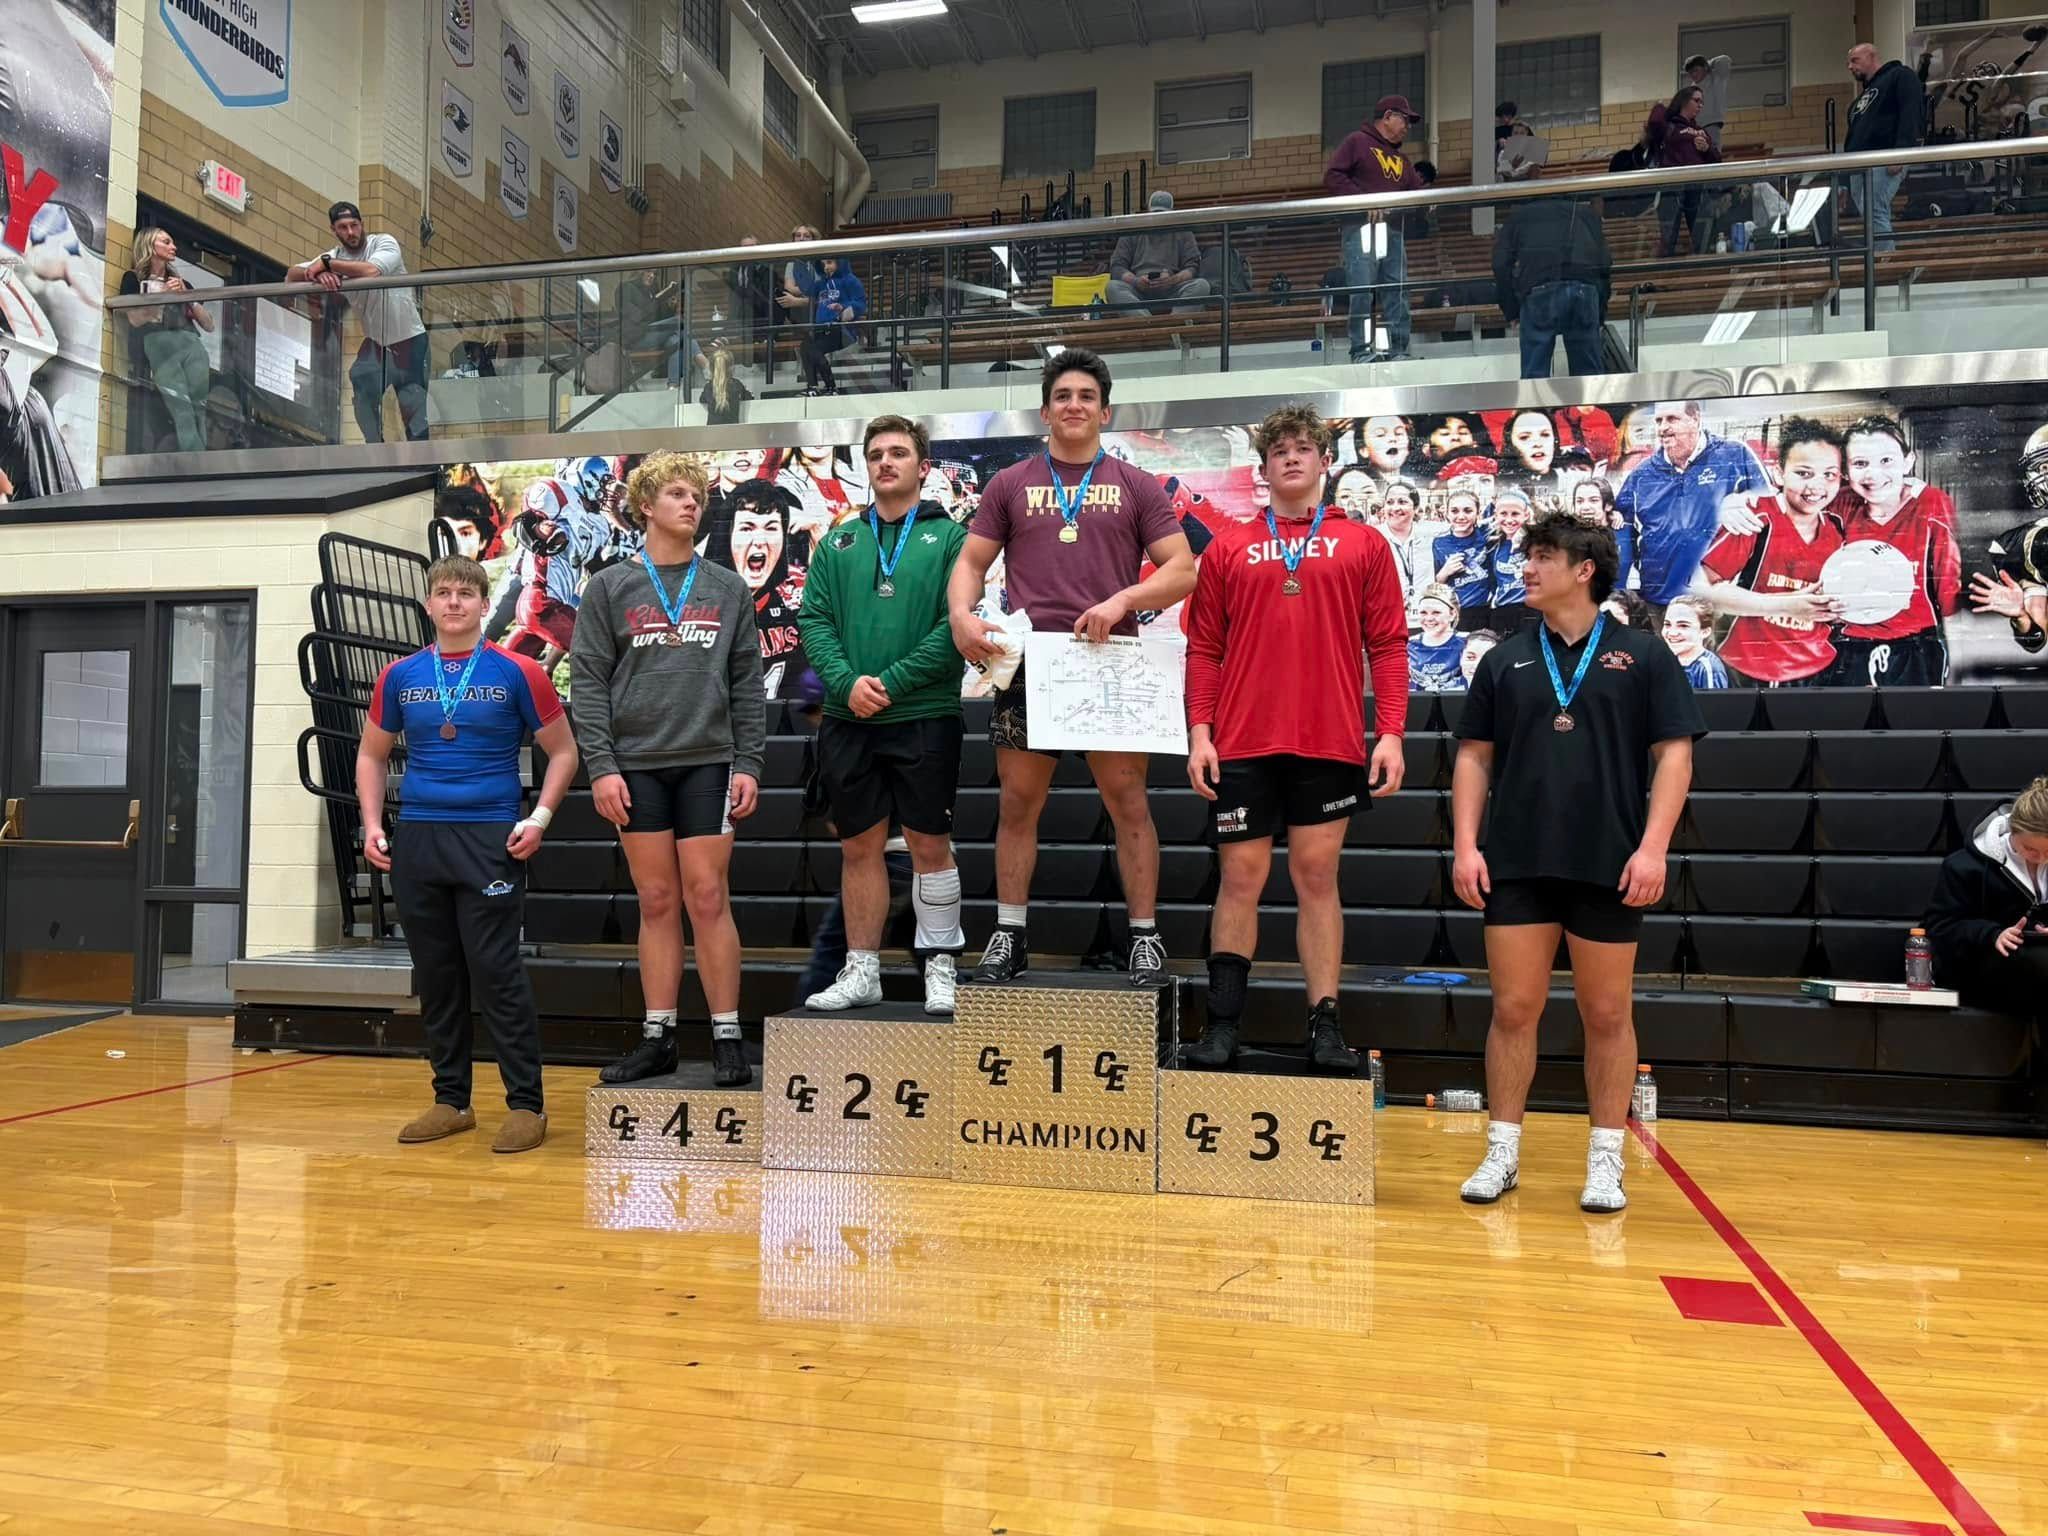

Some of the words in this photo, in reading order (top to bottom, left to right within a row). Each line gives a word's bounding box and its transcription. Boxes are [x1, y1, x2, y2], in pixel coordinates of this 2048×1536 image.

[168, 0, 285, 80] HUNDERBIRDS
[1370, 146, 1404, 182] W
[217, 166, 242, 200] EXIT
[1026, 504, 1120, 517] WRELING
[1247, 536, 1340, 565] SIDNEY
[632, 624, 718, 649] wretling
[400, 686, 507, 705] BEACATS
[978, 1046, 1012, 1086] CE
[1043, 1044, 1063, 1093] 1
[1094, 1051, 1129, 1092] CE
[786, 1075, 818, 1112] CE
[843, 1073, 871, 1120] 2
[895, 1080, 930, 1118] CE
[609, 1104, 640, 1141] CE
[661, 1102, 693, 1147] 4
[715, 1107, 747, 1144] CE
[960, 1119, 1146, 1153] CHAMPION
[1185, 1113, 1222, 1153] CE
[1249, 1111, 1280, 1161] 3
[1308, 1120, 1346, 1161] CE
